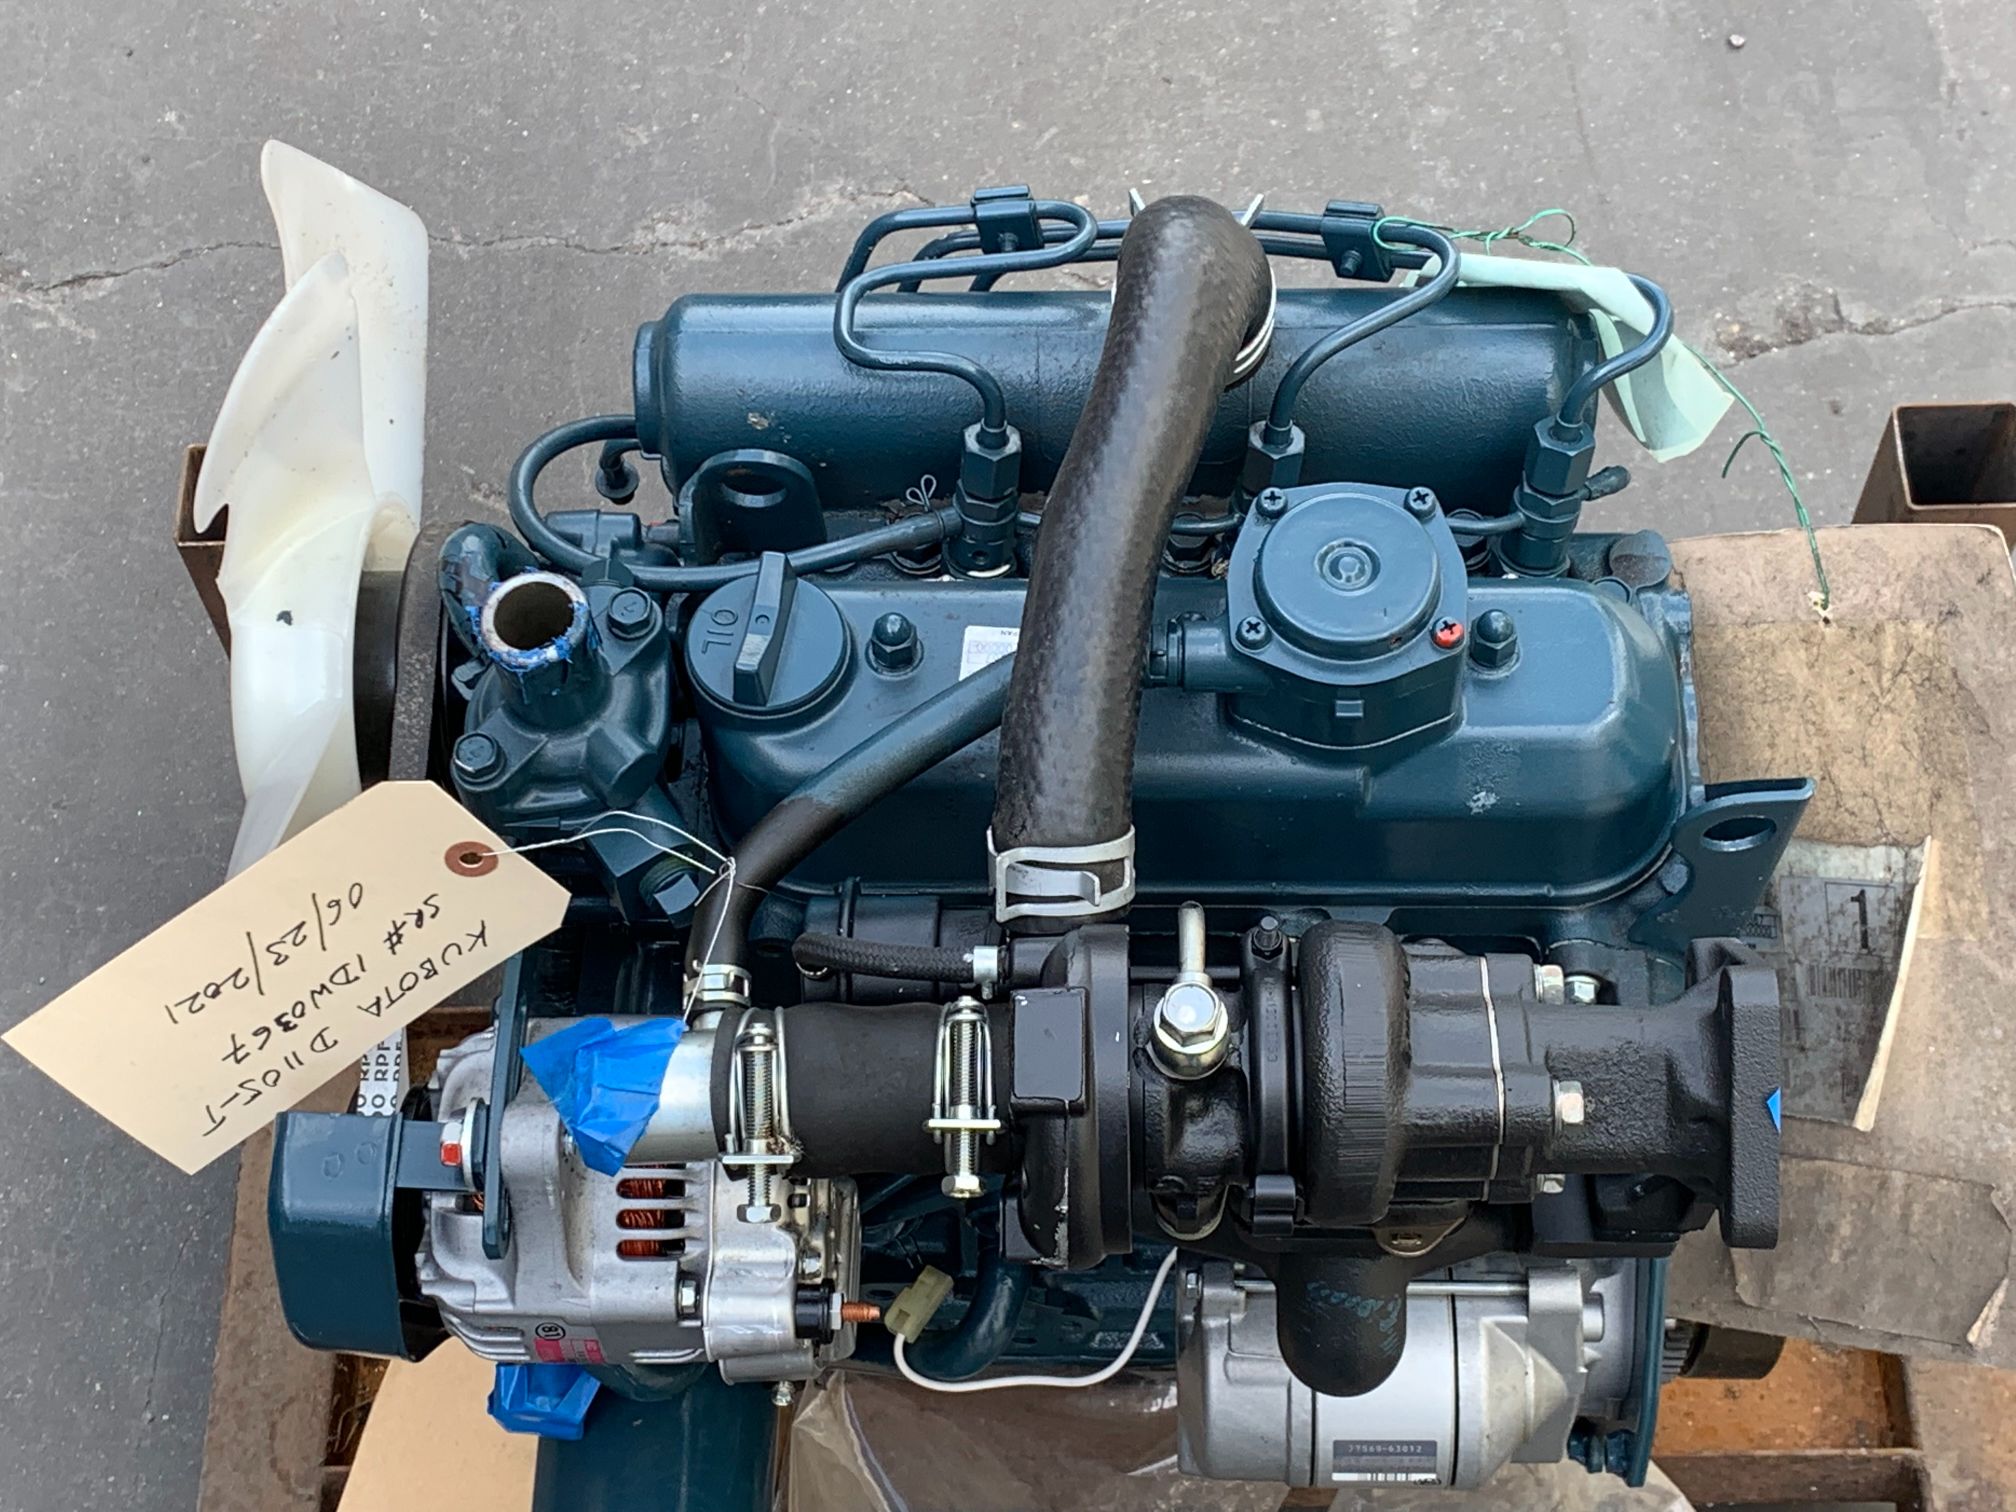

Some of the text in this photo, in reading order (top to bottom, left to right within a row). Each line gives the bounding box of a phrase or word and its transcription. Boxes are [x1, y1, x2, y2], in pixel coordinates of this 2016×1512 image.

[701, 609, 739, 655] OIL
[383, 893, 442, 955] SR#
[1850, 888, 1869, 950] 1
[165, 882, 364, 1024] 06/23/2021
[357, 919, 490, 1019] KUBOTA
